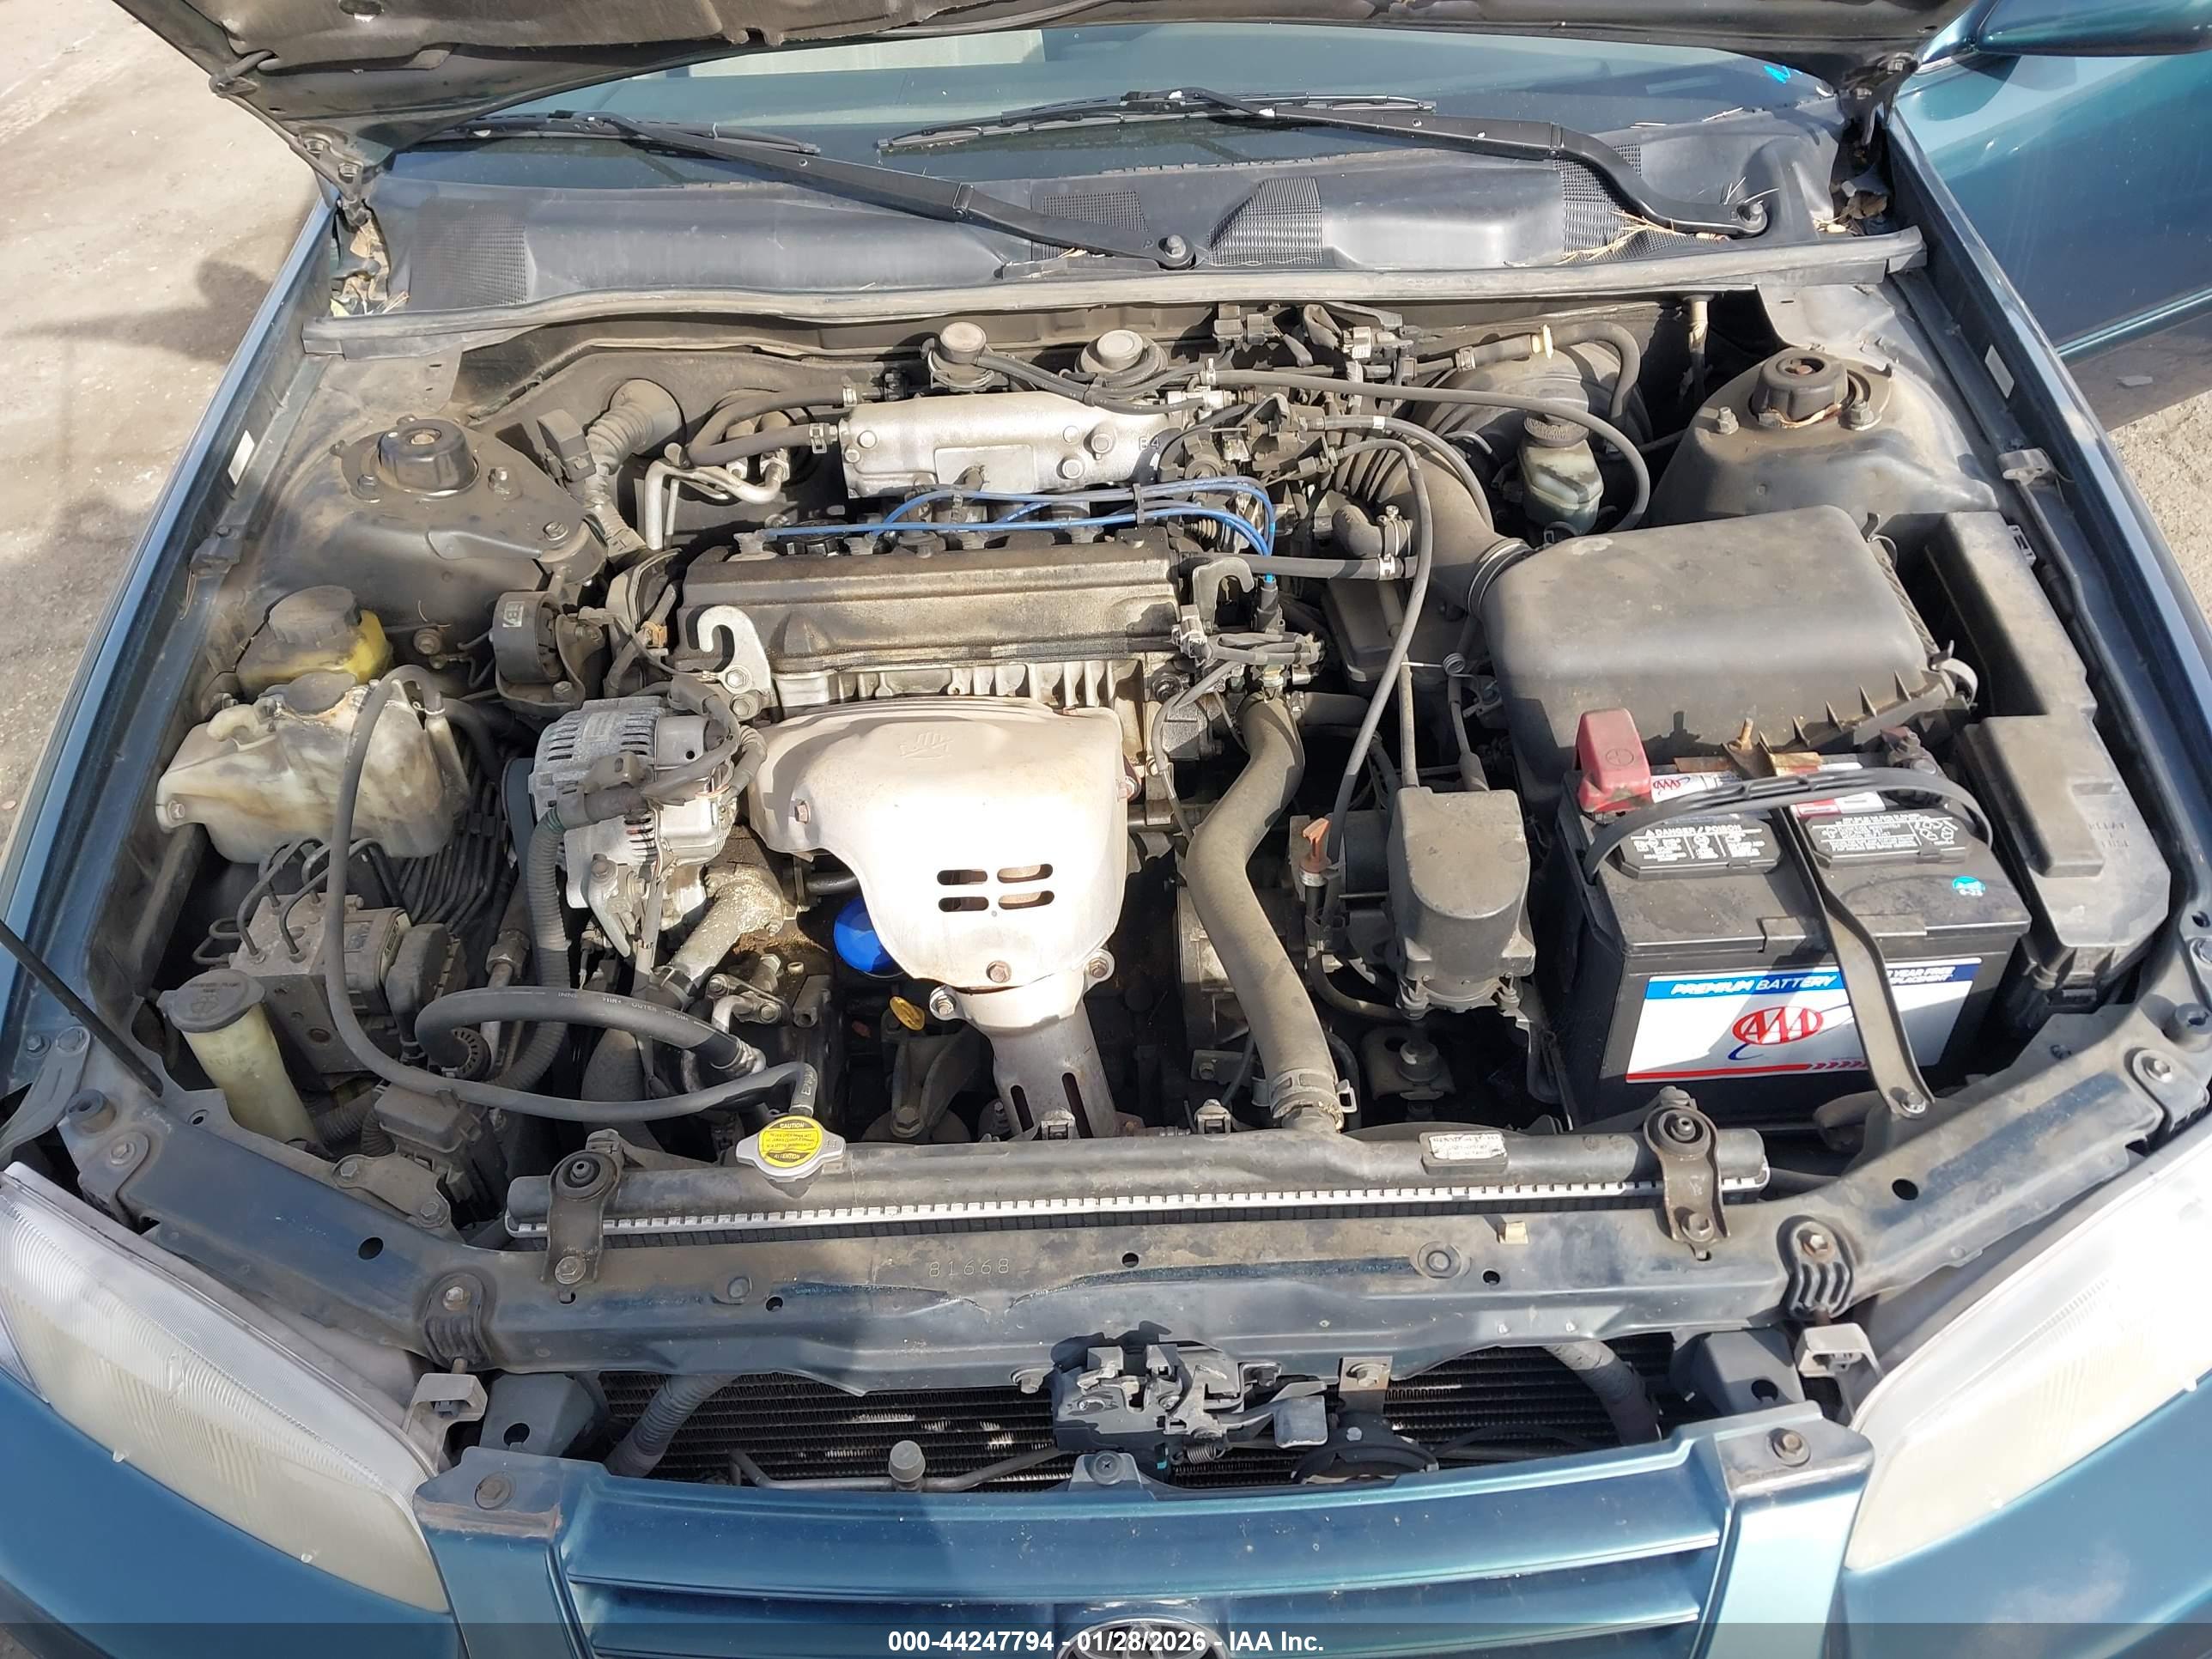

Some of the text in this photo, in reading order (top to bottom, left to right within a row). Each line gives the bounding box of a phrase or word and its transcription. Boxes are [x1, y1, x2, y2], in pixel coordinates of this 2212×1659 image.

[1139, 437, 1160, 451] B4
[1656, 826, 1695, 836] DANGER
[1894, 969, 1924, 977] YEAR
[1671, 975, 1837, 994] PREMIUM BATTERY
[1734, 1006, 1822, 1045] AAA
[929, 1258, 1009, 1277] 81668
